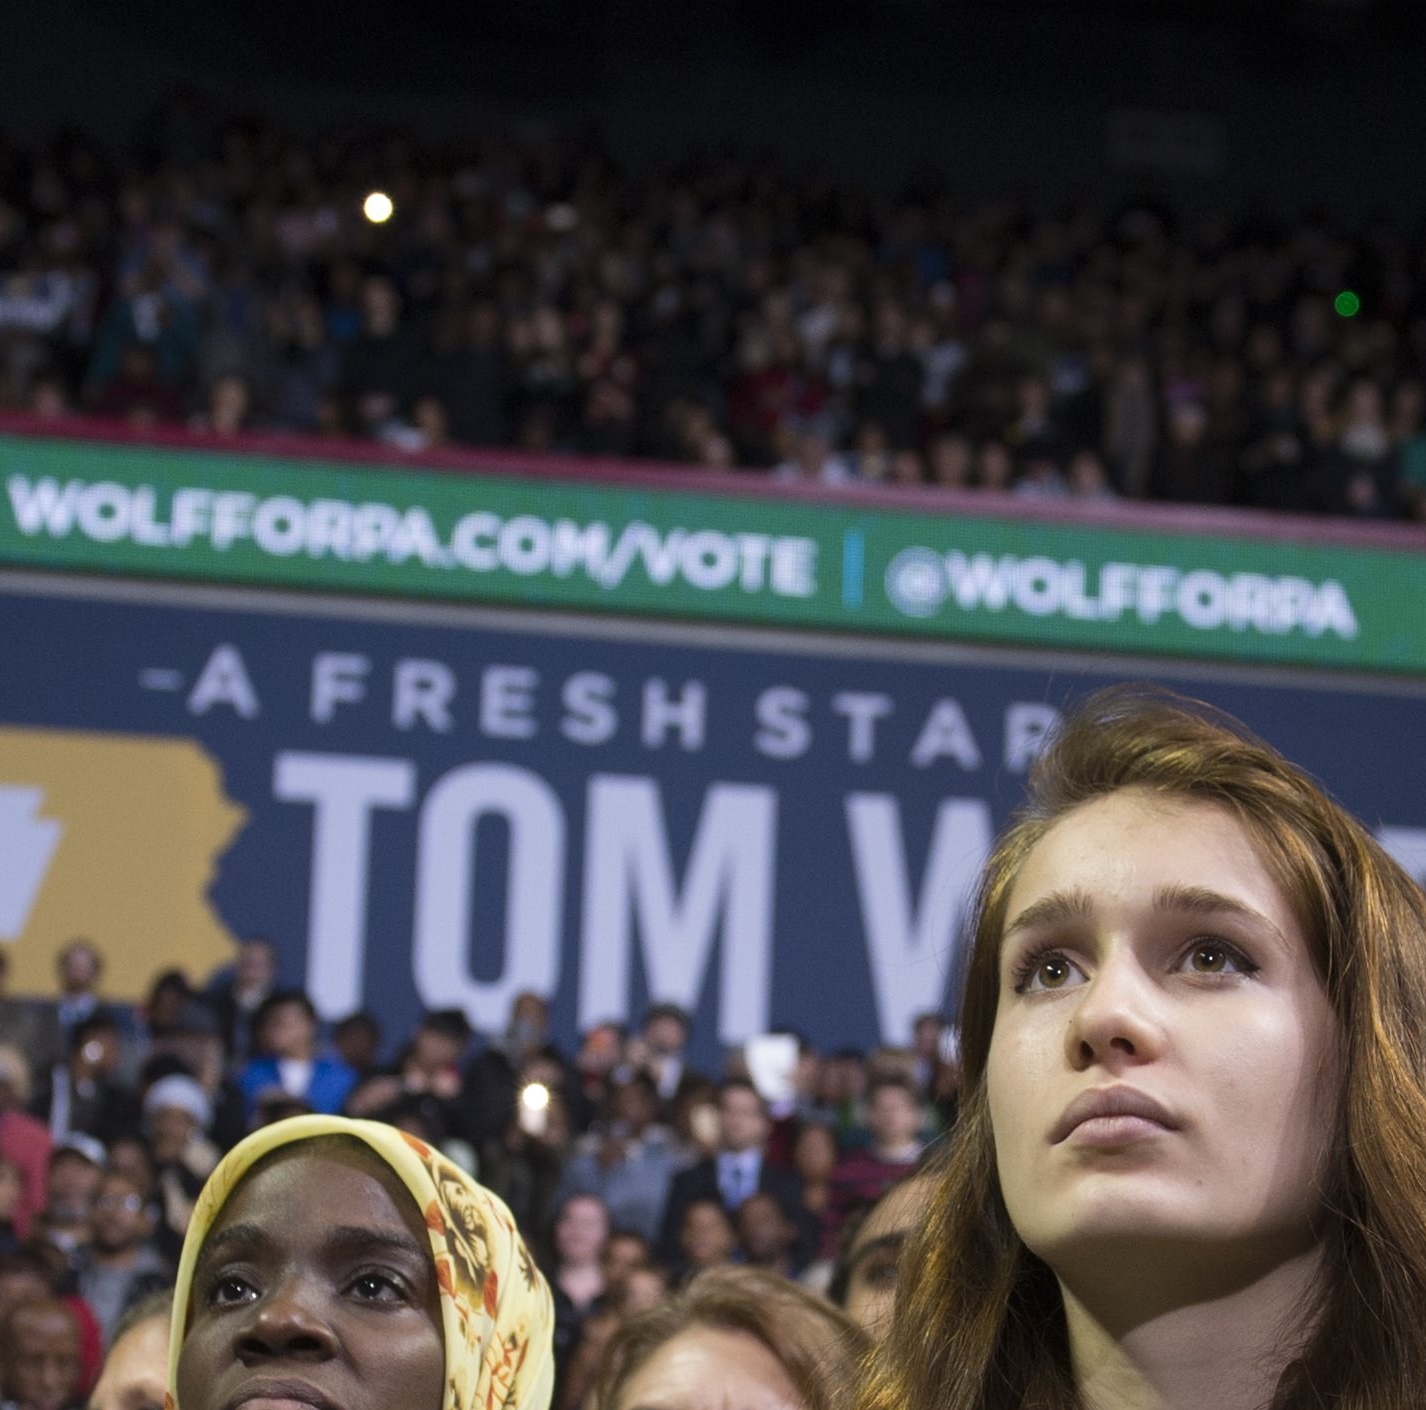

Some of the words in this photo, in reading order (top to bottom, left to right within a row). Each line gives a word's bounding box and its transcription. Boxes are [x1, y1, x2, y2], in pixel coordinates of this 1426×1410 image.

[7, 473, 819, 597] WOLFFORPA.COM/VOTE
[884, 545, 1359, 641] @WOLFFORPA
[310, 650, 708, 752] FRESH
[753, 684, 1066, 773] STAR
[274, 750, 778, 1045] TOM
